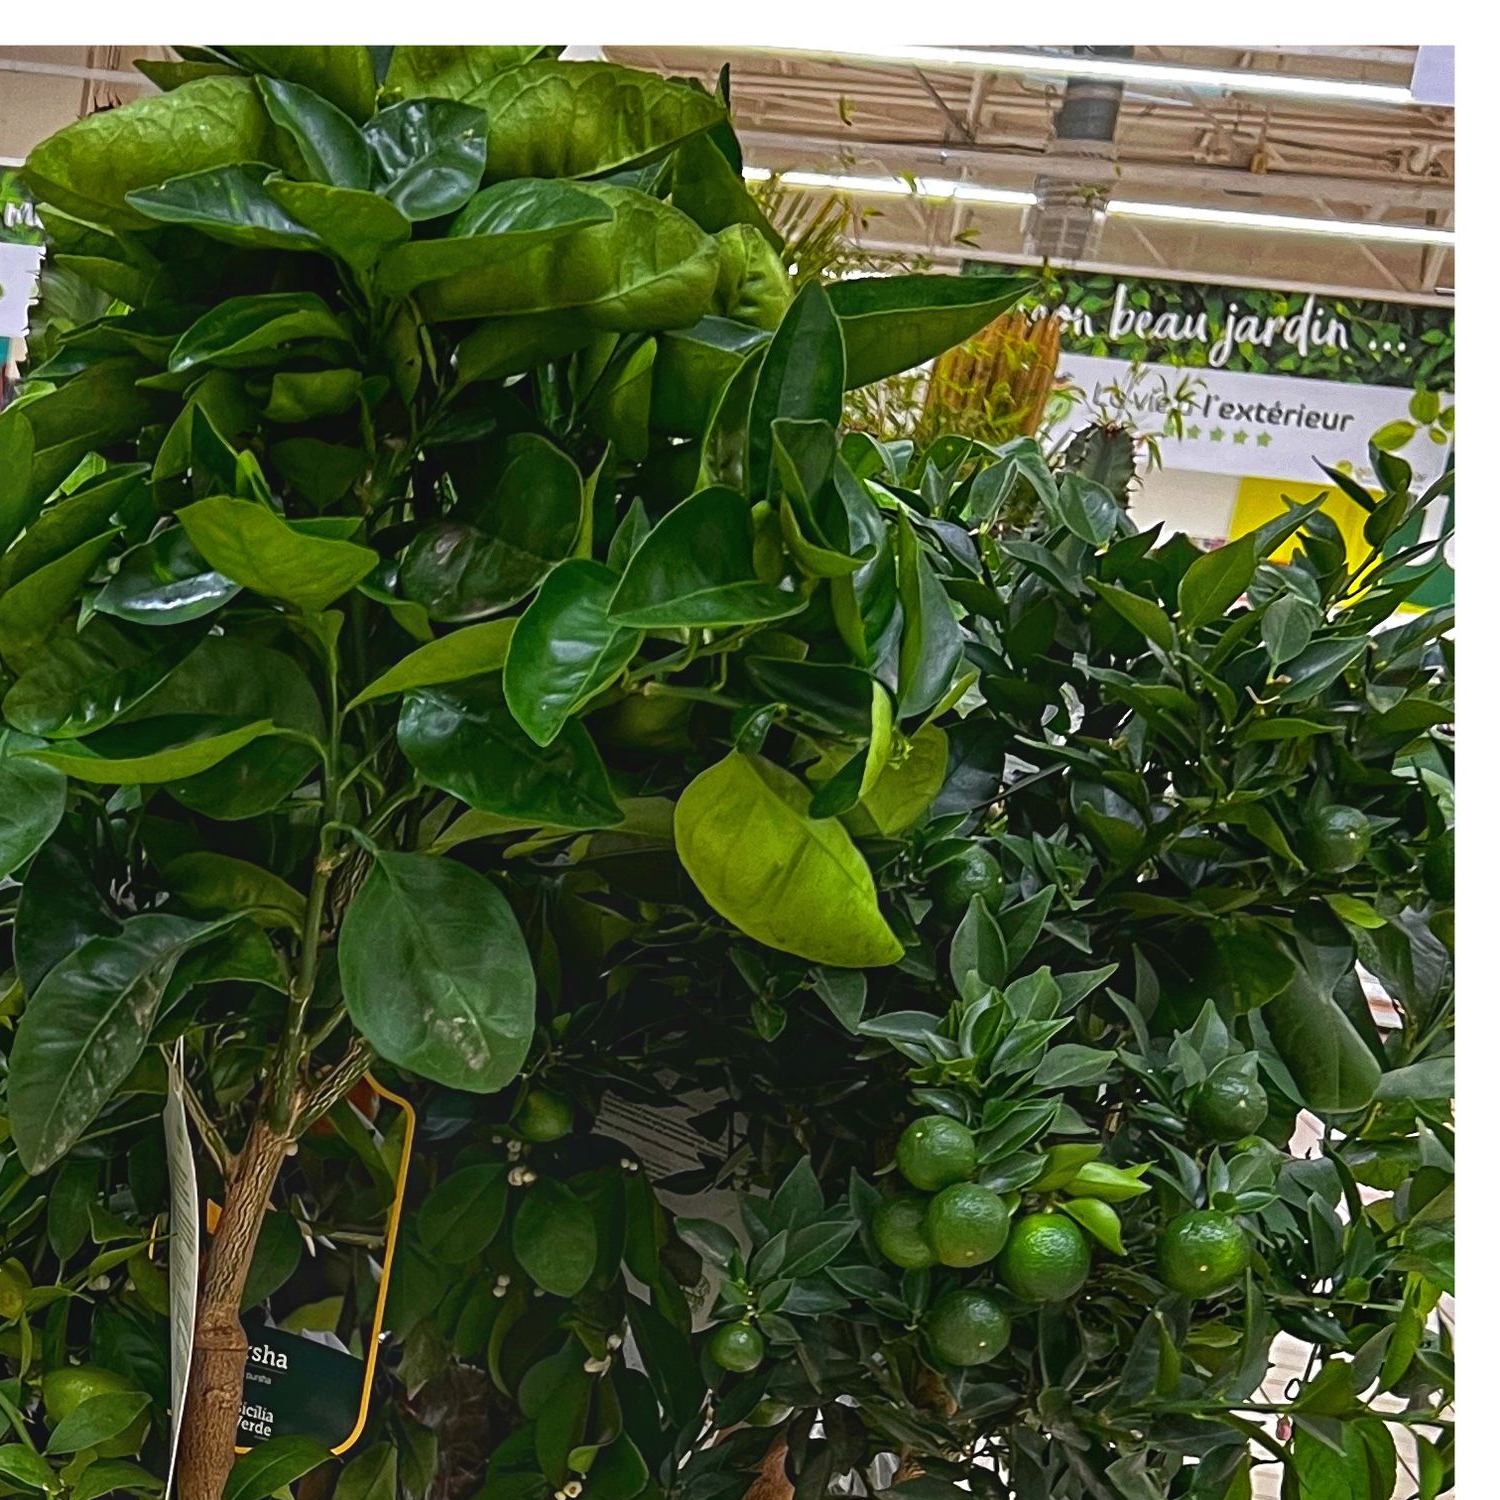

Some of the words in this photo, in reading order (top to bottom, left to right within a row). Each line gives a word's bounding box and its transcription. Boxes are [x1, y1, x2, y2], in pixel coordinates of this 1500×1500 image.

[1108, 283, 1209, 343] beau
[1208, 292, 1350, 368] jardin
[1203, 393, 1356, 432] l'extérieur
[239, 1402, 274, 1424] icilia
